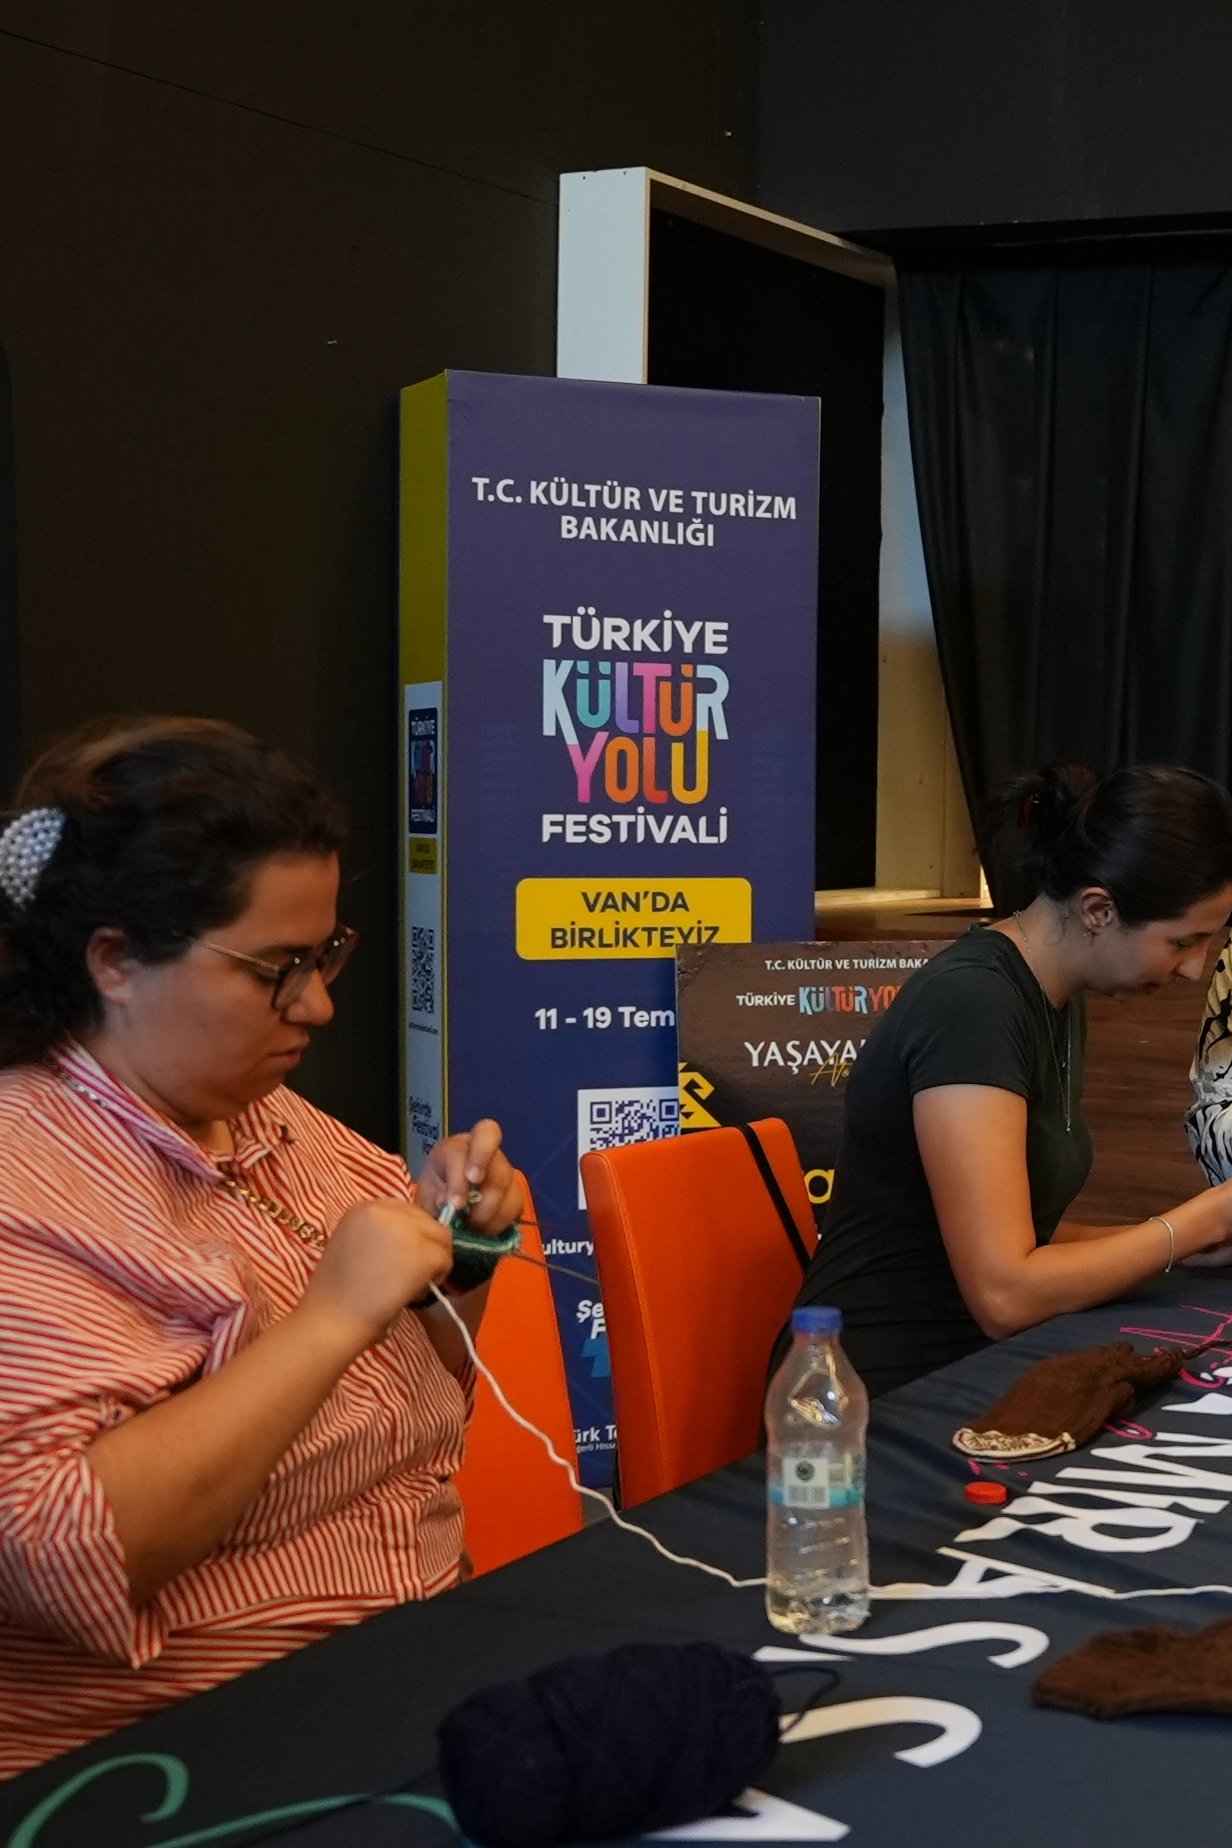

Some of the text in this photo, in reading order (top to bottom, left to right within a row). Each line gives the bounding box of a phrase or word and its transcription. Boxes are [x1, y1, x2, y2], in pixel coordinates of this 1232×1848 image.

[471, 476, 797, 520] T.C. KÜLTÜR VE TURİZM
[560, 515, 715, 547] BAKANLIĞI
[542, 606, 730, 655] TÜRKİYE
[542, 658, 730, 744] KÜLTÜR
[566, 730, 710, 805] YOLU
[542, 805, 729, 845] FESTİVALİ
[581, 890, 690, 914] VAN'DA
[550, 919, 720, 949] BİRLİKTEYİZ
[764, 956, 929, 971] T.C. KÜLTÜR VE TURİZM BAK
[735, 984, 902, 1016] TÜRKİYE KÜLTÜR YO
[534, 1007, 558, 1030] 11
[583, 1006, 612, 1029] 19
[617, 1006, 676, 1028] Tem
[743, 1038, 868, 1075] YAŞAYA
[541, 1237, 595, 1257] ultury
